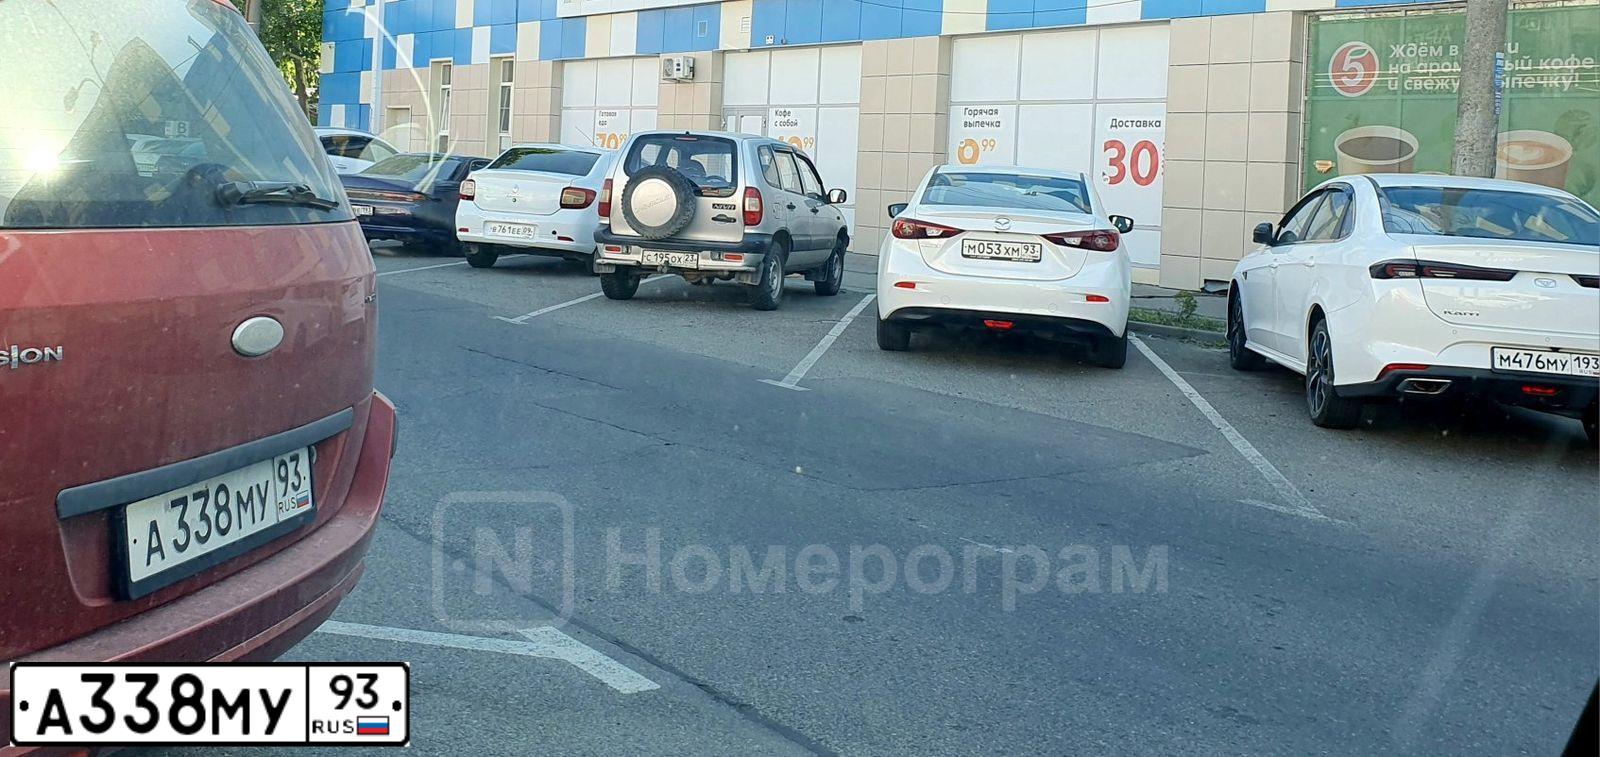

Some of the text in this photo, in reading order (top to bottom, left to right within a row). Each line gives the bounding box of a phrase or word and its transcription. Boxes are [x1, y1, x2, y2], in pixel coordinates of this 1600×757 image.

[1389, 42, 1459, 58] Ждём в
[1389, 63, 1411, 74] на
[1540, 54, 1595, 75] кофе
[1388, 73, 1580, 93] и свежу ыпечку!
[775, 109, 792, 118] Кофе
[963, 107, 999, 118] Горячая
[779, 118, 798, 127] собой
[963, 120, 1001, 128] выпечка
[1110, 118, 1162, 129] Доставка
[1104, 139, 1159, 186] 30
[967, 242, 1036, 256] М053ХМ 93
[685, 254, 695, 262] 23
[1499, 351, 1600, 371] М476МУ 193
[146, 453, 301, 567] А338МУ 93
[279, 496, 297, 513] RUS
